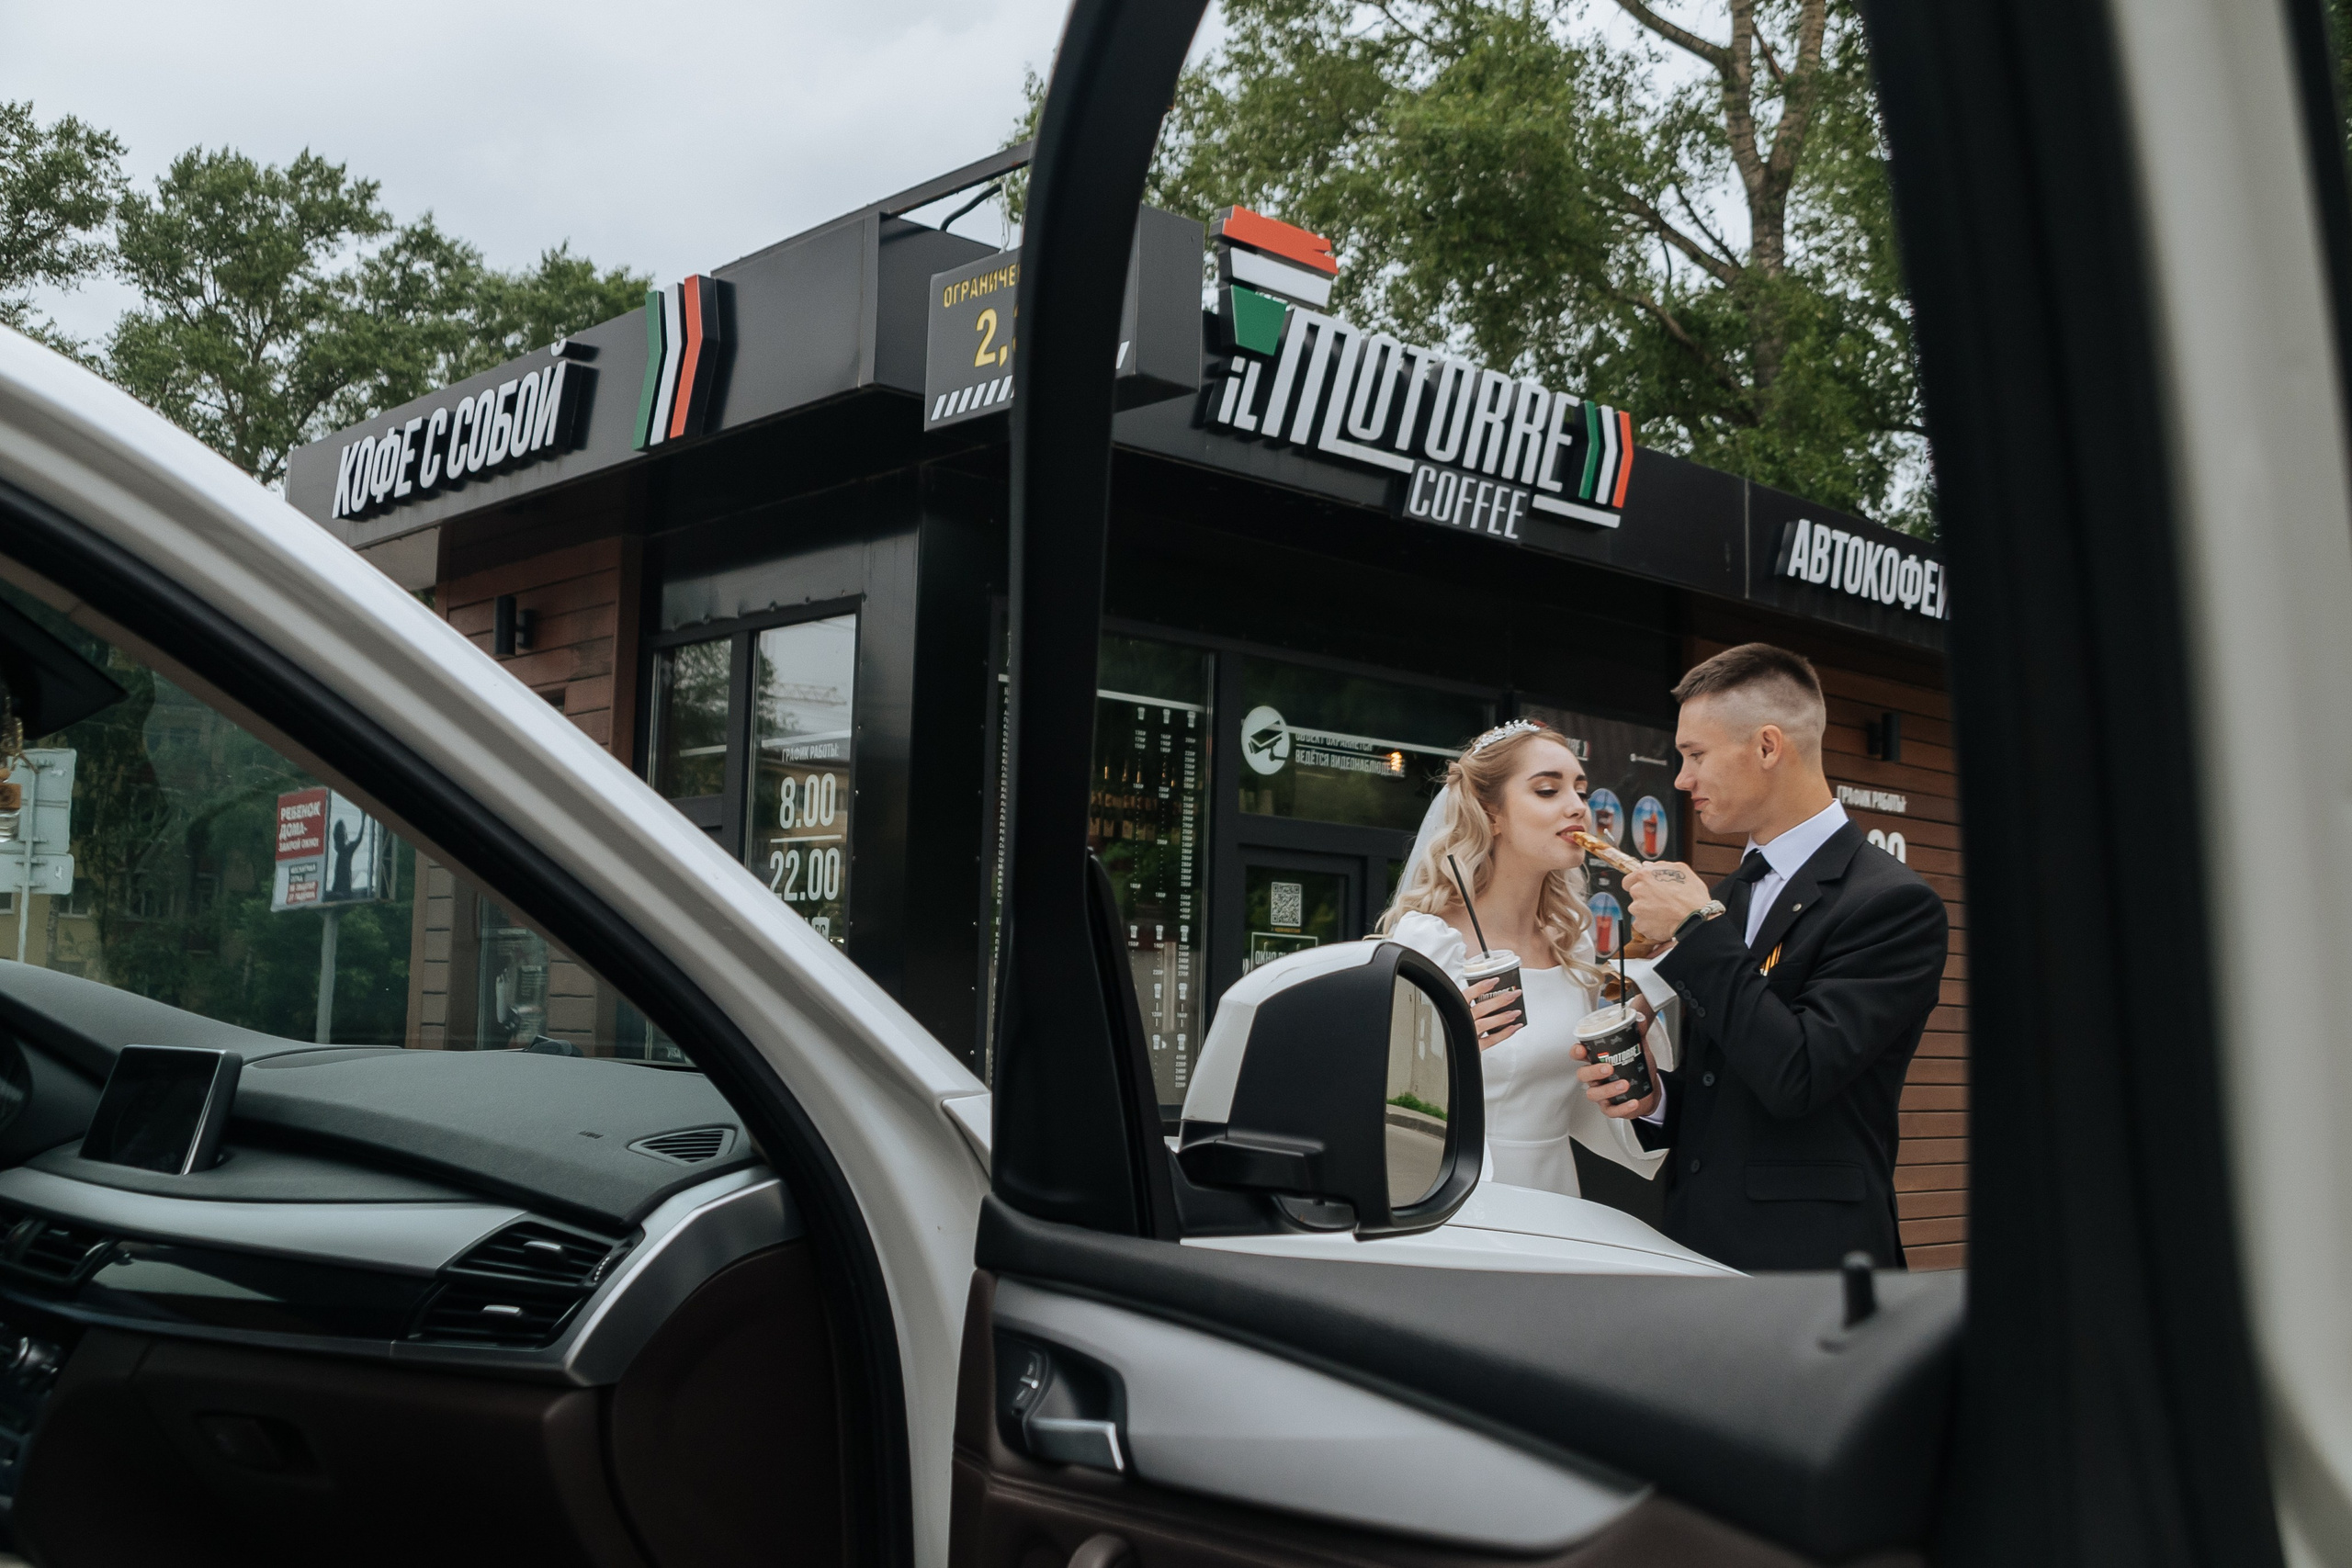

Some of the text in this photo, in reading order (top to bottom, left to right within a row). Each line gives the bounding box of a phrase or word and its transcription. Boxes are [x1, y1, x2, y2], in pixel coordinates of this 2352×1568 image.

[944, 263, 1021, 308] ОГРАНИЧЕ
[974, 308, 1019, 367] 2,
[332, 337, 568, 520] КОФЕ С СОБОЙ
[1261, 307, 1580, 493] MOTORRE
[1408, 463, 1530, 541] COFFEE
[782, 745, 809, 762] ГРАФИК
[1295, 749, 1329, 768] ВЕДЁТСЯ
[779, 772, 836, 830] 8.00
[769, 847, 841, 902] 22.00
